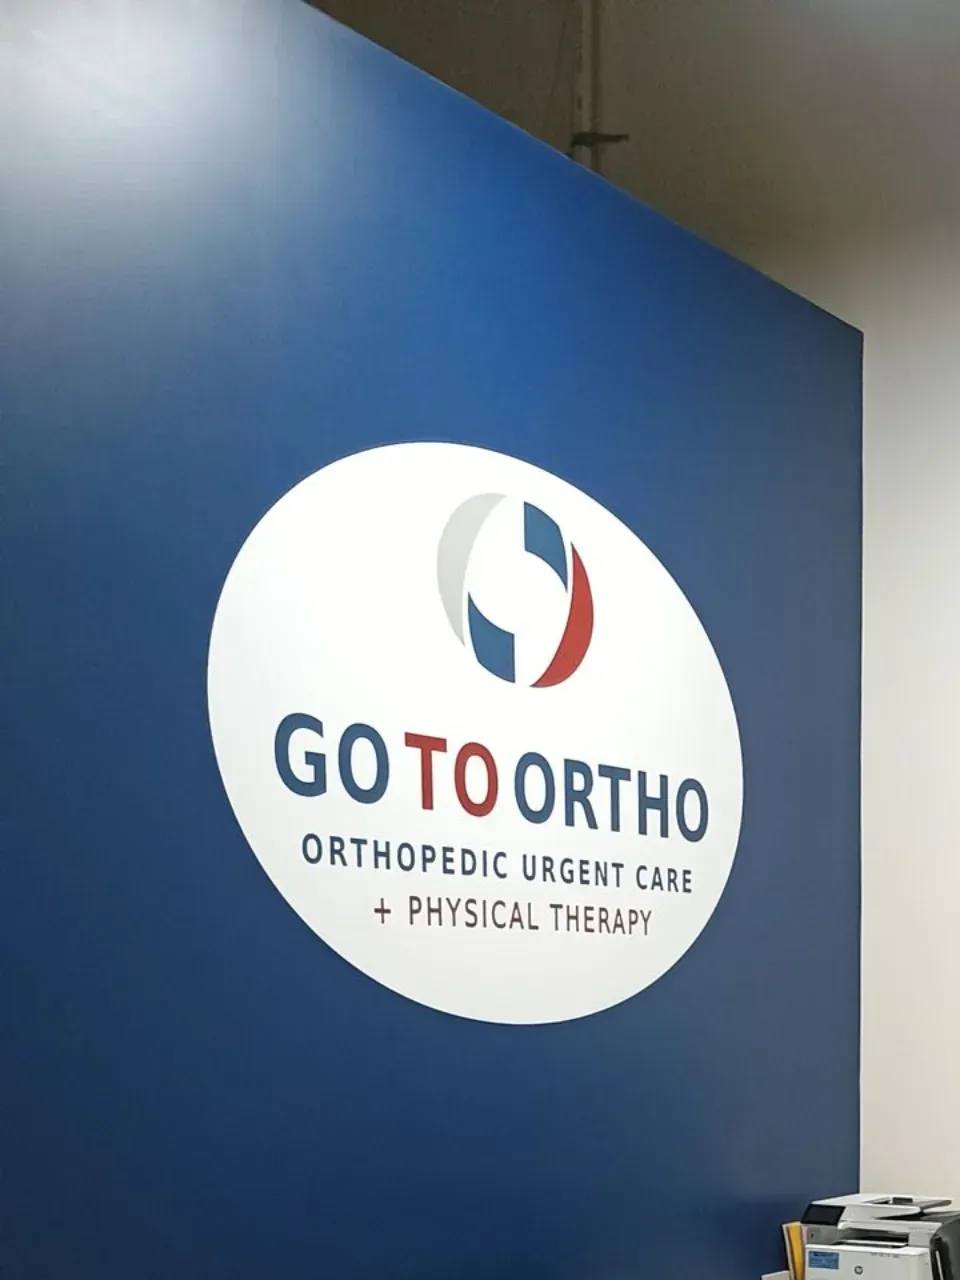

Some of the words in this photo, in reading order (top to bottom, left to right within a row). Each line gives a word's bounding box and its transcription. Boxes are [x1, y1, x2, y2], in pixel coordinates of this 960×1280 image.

[275, 713, 389, 804] GO
[405, 732, 498, 817] TO
[515, 752, 708, 842] ORTHO
[302, 833, 508, 879] ORTHOPEDIC
[522, 854, 625, 888] URGENT
[635, 865, 694, 893] CARE
[408, 896, 539, 930] PHYSICAL
[549, 903, 652, 936] THERAPY
